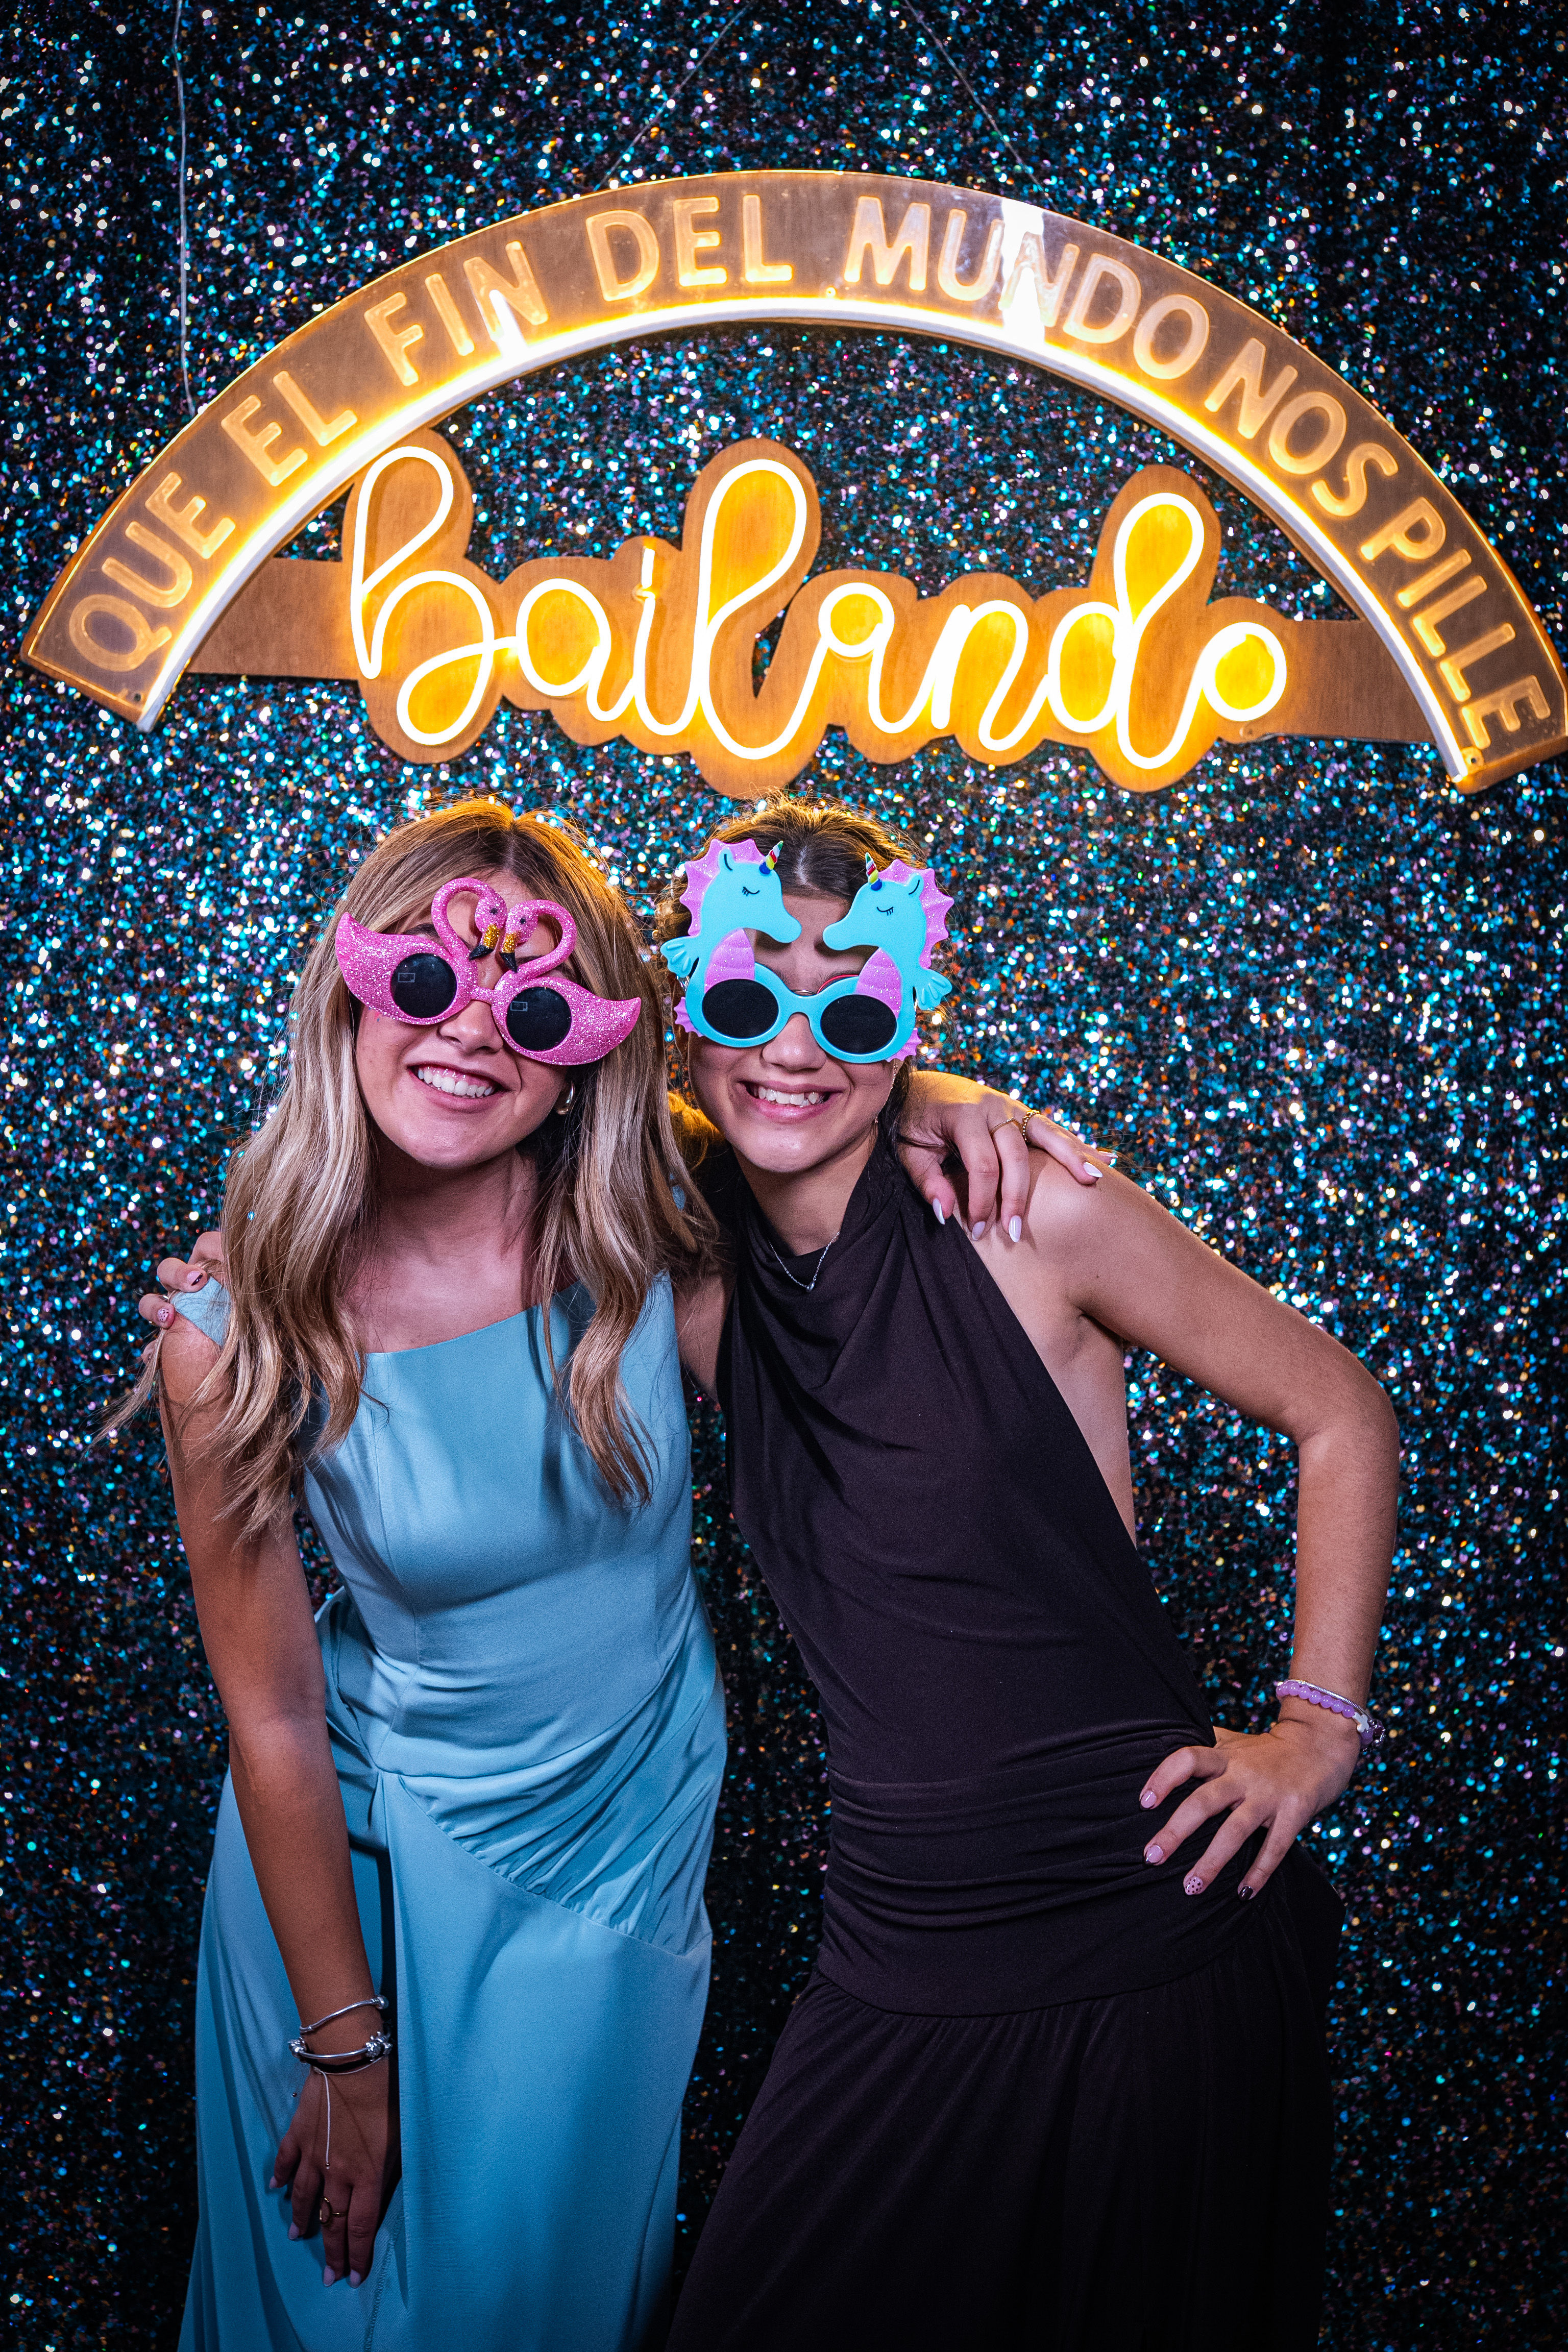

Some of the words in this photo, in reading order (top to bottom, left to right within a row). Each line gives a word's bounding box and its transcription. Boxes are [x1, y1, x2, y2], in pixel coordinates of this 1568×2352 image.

[69, 471, 236, 672] QUE
[221, 371, 358, 486] EL
[364, 241, 549, 386] FIN
[585, 194, 793, 302] DEL
[844, 195, 1210, 380] MUNDO
[1204, 337, 1398, 517] NOS
[1361, 497, 1551, 750] PILLE
[350, 445, 1287, 769] bailando
